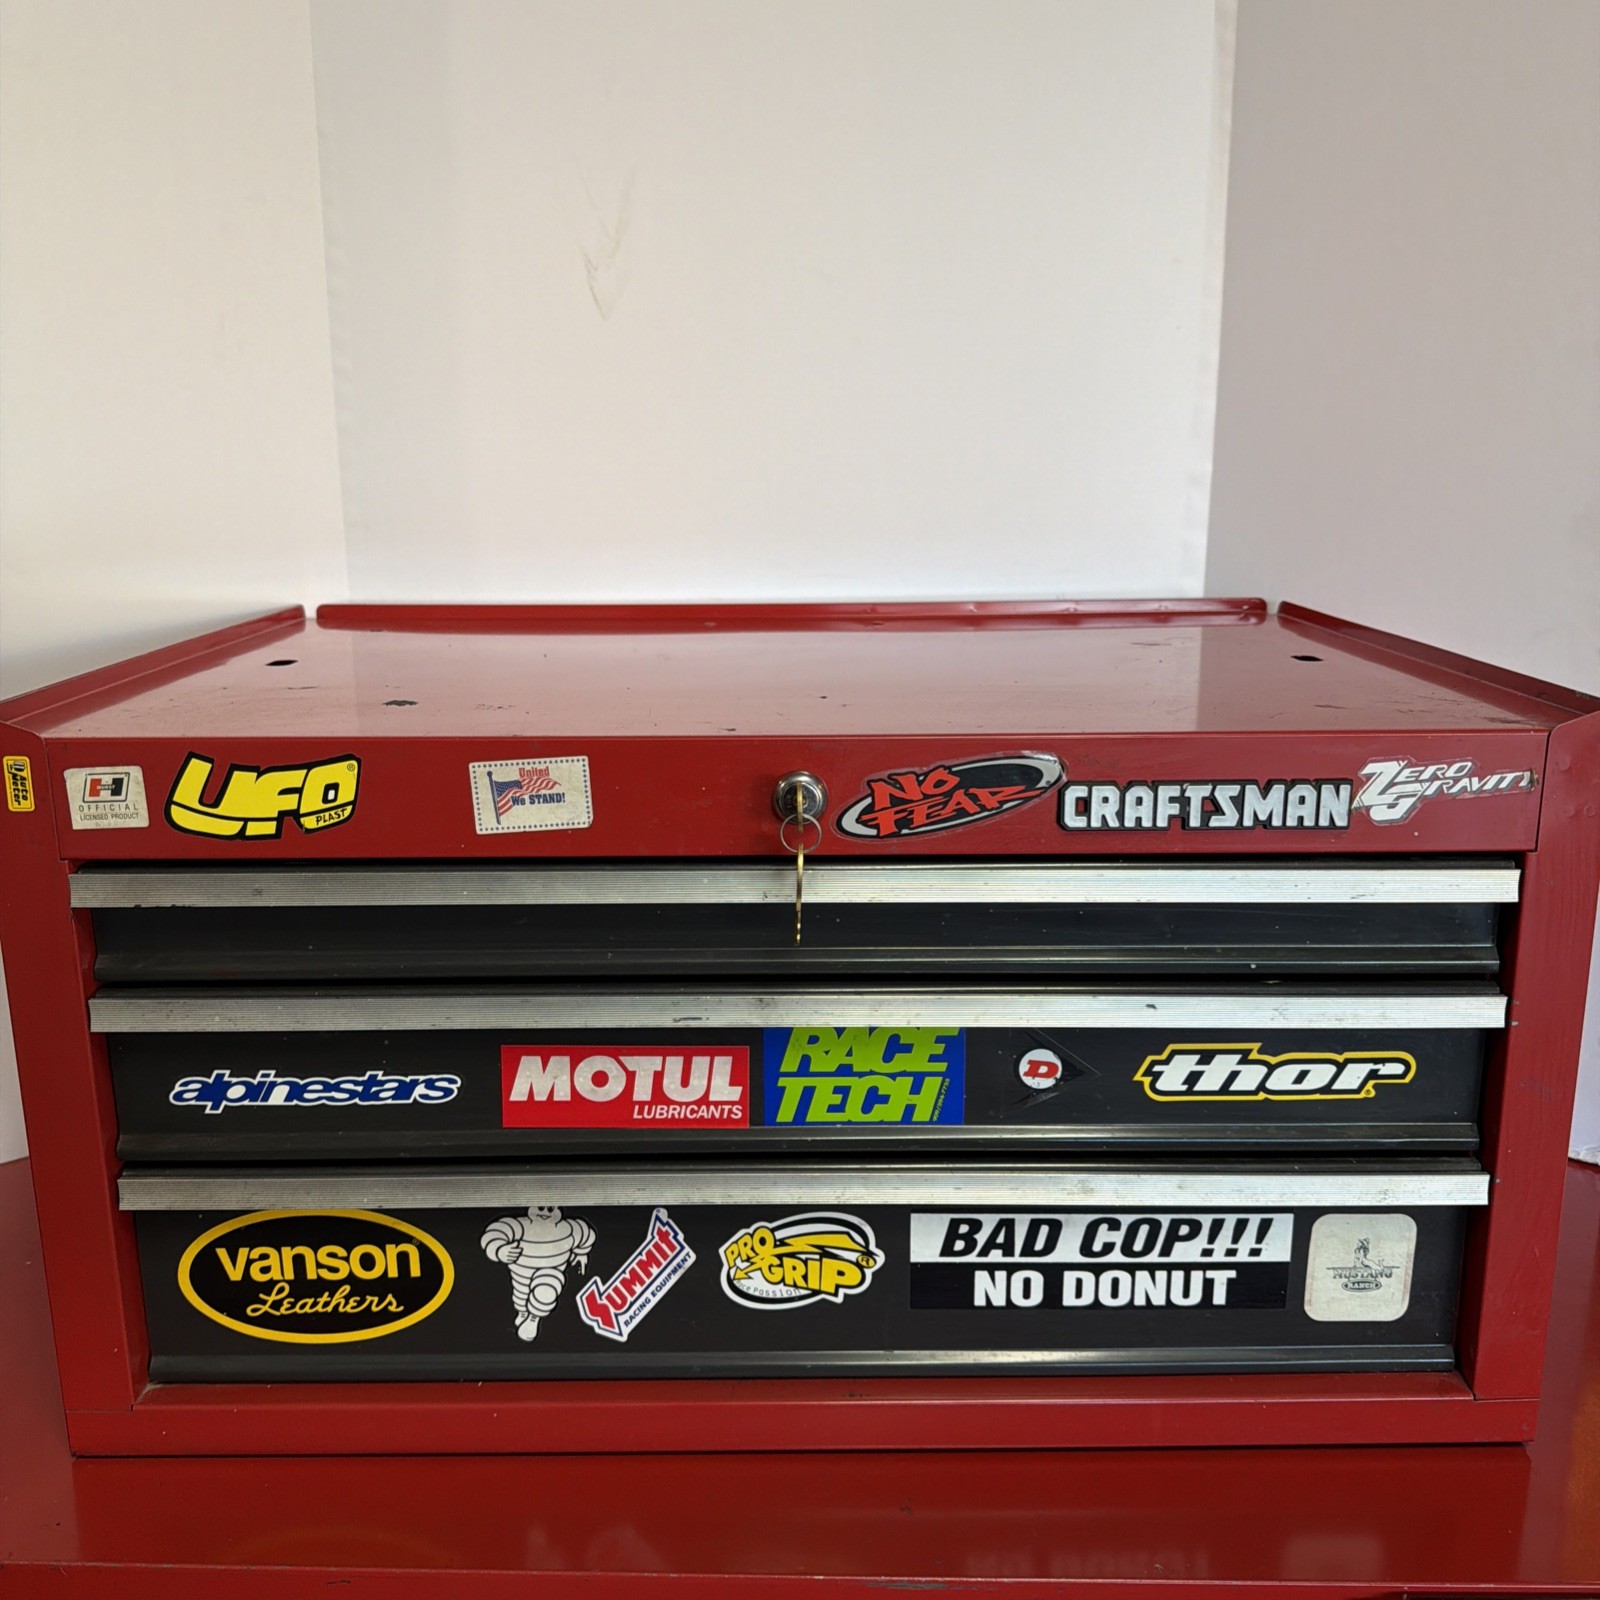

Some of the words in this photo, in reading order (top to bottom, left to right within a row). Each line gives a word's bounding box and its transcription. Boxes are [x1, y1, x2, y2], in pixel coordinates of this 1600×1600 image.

[518, 765, 550, 779] United
[870, 768, 961, 811] NO
[1351, 760, 1473, 810] ZERO
[78, 803, 139, 813] OFFICIAL
[110, 812, 139, 820] PRODUCT
[170, 756, 358, 837] UFO
[315, 808, 348, 826] PLAST
[510, 795, 526, 806] We
[529, 792, 565, 805] STAND!
[859, 785, 1046, 837] FEAR
[1062, 783, 1352, 829] CRAFTSMAN
[779, 1026, 960, 1073] RACE
[169, 1069, 462, 1114] alpinestars
[509, 1055, 743, 1102] MOTUL
[1151, 1054, 1405, 1092] thor
[633, 1104, 743, 1120] LUBRICANTS
[775, 1075, 943, 1123] TECH
[725, 1227, 775, 1268] PRO
[939, 1217, 1063, 1258] BAD
[1079, 1217, 1274, 1258] COP!!!
[215, 1242, 422, 1282] vanson
[761, 1254, 863, 1295] GRIP
[246, 1282, 404, 1317] Leathers
[622, 1297, 652, 1328] RACING
[651, 1251, 692, 1298] EQUIPMENT
[973, 1270, 1044, 1307] NO
[1062, 1270, 1237, 1307] DONUT
